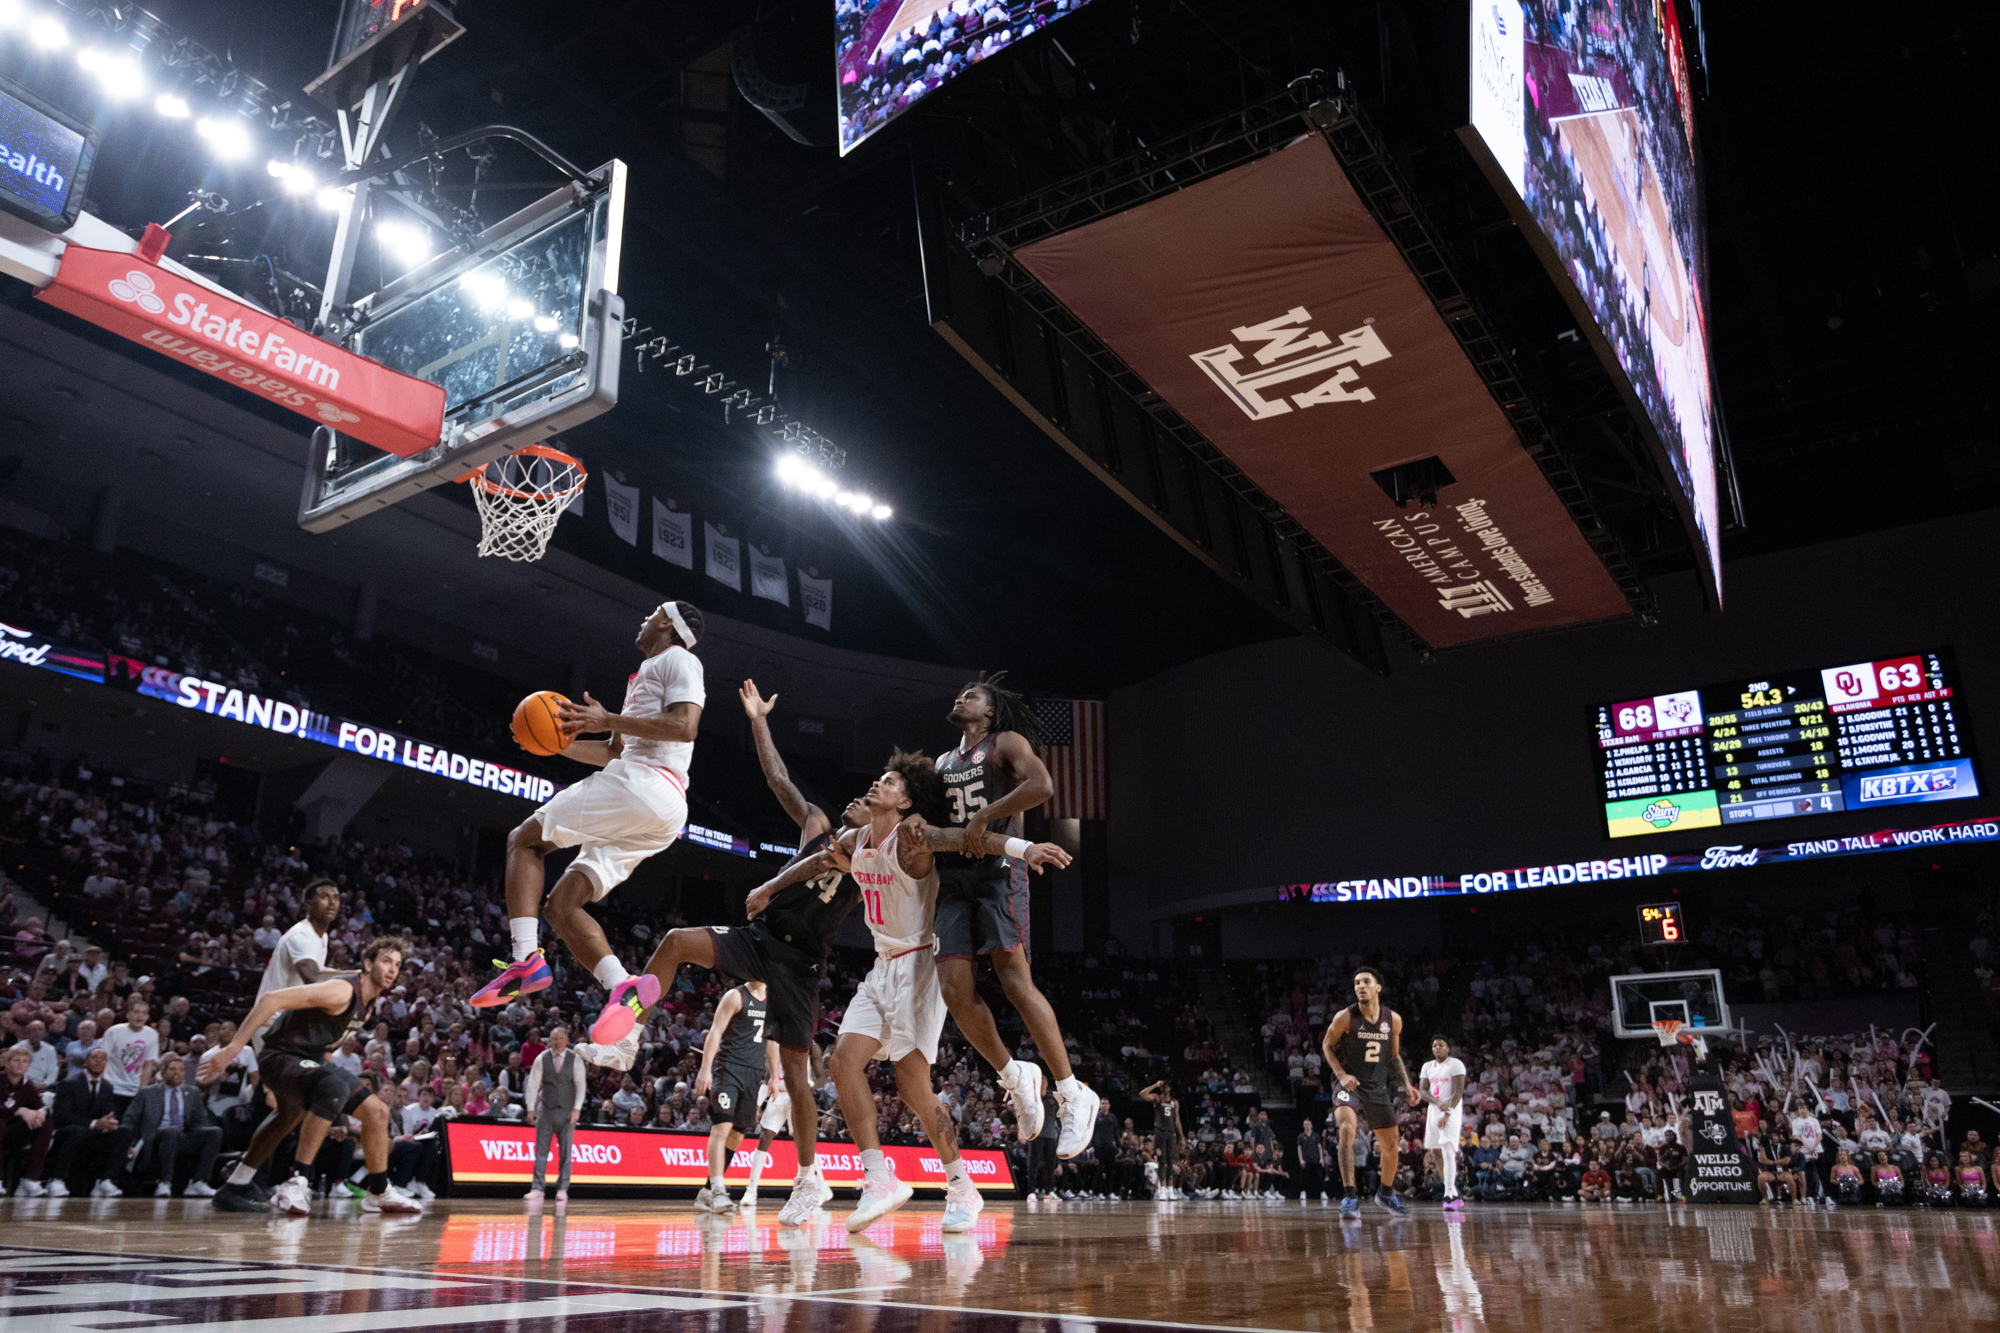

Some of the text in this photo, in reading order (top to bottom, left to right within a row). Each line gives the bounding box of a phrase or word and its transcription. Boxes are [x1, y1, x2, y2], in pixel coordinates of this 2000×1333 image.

[657, 526, 686, 551] 1923
[1405, 512, 1480, 580] CAMPUS
[1476, 526, 1509, 551] love
[1372, 518, 1453, 584] AMERICAN
[1490, 546, 1536, 582] students
[1519, 579, 1554, 608] Where
[1879, 663, 1922, 691] 63
[1930, 660, 1940, 672] 2
[1932, 678, 1943, 690] 9
[1748, 682, 1769, 693] 2ND
[1741, 688, 1782, 709] 54.3
[1832, 688, 1948, 713] OKLAHOMA PTS REB AST PF
[1599, 713, 1607, 723] 2
[1619, 705, 1653, 730] 68
[1709, 700, 1824, 726] 20/55 FIELD GOALS 20/43
[1846, 707, 1908, 723] B.GOODINE 21
[1598, 729, 1612, 739] 10
[1713, 714, 1823, 738] 4/24 THREE POINTERS 9/21
[1848, 720, 1894, 734] D.FORSYTHE
[177, 676, 555, 803] STAND! FOR LEADERSHIP
[1601, 737, 1624, 747] TEXAS
[1713, 727, 1830, 752] 24/29 FREE THROWS 14/18
[1837, 731, 1897, 746] 10 S.GODWIN
[1839, 740, 1915, 757] 14 J.MOORE 20
[1606, 741, 1677, 758] 1 Z.PHELPS 12 4
[1725, 741, 1824, 763] 9 ASSISTS 18
[1841, 759, 1853, 768] 35
[1952, 745, 1960, 754] 3
[1604, 762, 1682, 779] 11 A.GARCIA 9 11
[1606, 760, 1613, 768] 4
[1656, 753, 1667, 762] 12
[1726, 755, 1826, 776] 13 TURNOVERS 11
[943, 765, 984, 783] SOONERS
[1605, 780, 1616, 789] 15
[1659, 773, 1671, 782] 10
[1674, 771, 1682, 780] 6
[1728, 768, 1829, 790] 46 TOTAL REBOUNDS 18
[1607, 790, 1618, 799] 35
[1661, 784, 1672, 792] 10
[1730, 793, 1743, 803] 21
[1768, 786, 1801, 796] REBOUNDS
[1821, 783, 1829, 792] 2
[1864, 773, 1930, 798] KBTX
[945, 780, 988, 823] 35
[1729, 796, 1833, 819] STOPS 4
[1642, 804, 1680, 823] Starry
[688, 824, 733, 842] BEST IN TEXAS
[1787, 822, 1999, 856] STAND TALL WORK HARD
[760, 842, 797, 856] ONE MINUTE
[1699, 844, 1759, 869] Ford
[1337, 854, 1668, 901] STAND! FOR LEADERSHIP
[864, 889, 885, 925] 11
[1642, 907, 1670, 921] 54.1
[1662, 918, 1678, 940] 6
[753, 1019, 765, 1043] 7
[1357, 1032, 1388, 1040] SOONERS
[1365, 1041, 1380, 1062] 2
[1163, 1106, 1171, 1117] 5
[480, 1140, 622, 1164] WELL ARGO
[660, 1148, 709, 1167] WELL
[1694, 1154, 1740, 1164] WELLS
[1697, 1166, 1742, 1177] FARGO
